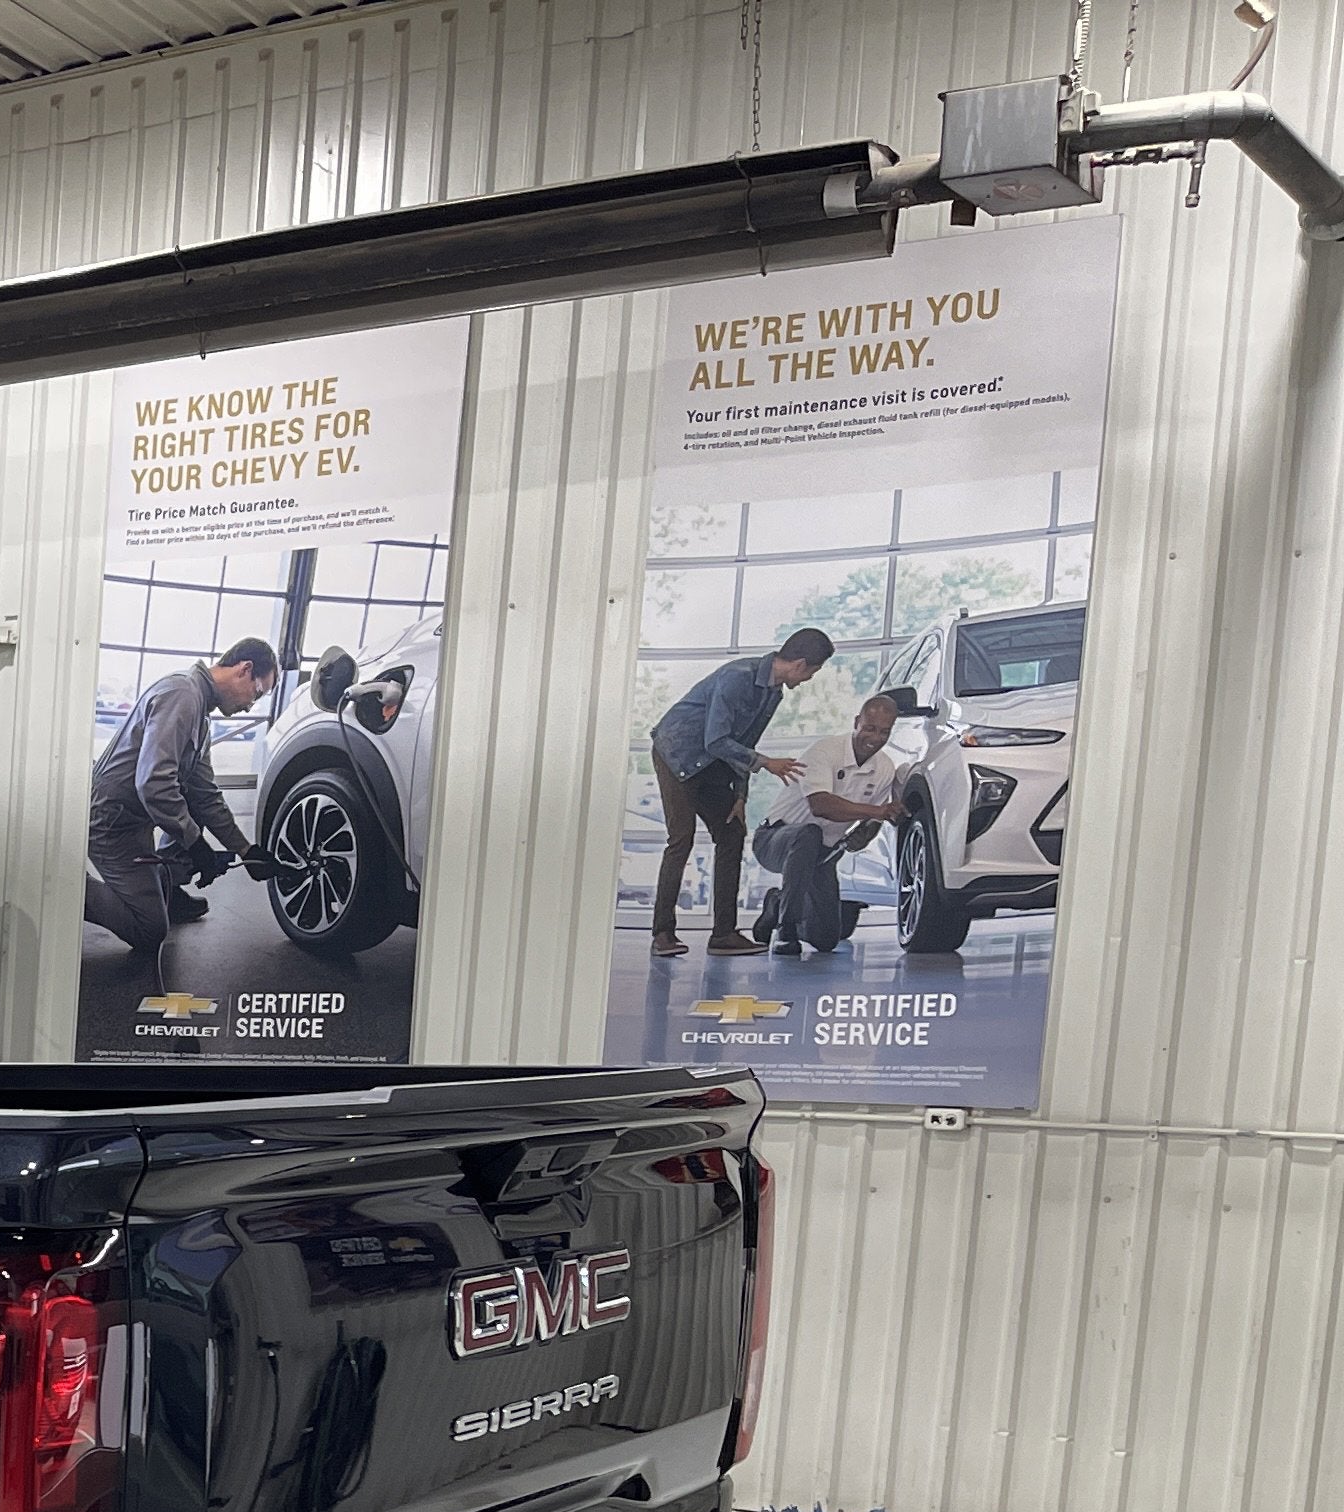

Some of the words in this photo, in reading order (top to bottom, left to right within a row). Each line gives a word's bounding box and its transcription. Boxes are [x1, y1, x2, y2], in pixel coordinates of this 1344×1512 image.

[695, 312, 807, 353] WE'RE
[818, 299, 913, 340] WITH
[927, 287, 1001, 326] YOU
[689, 357, 756, 392] ALL
[768, 346, 837, 384] THE
[849, 336, 935, 376] WAY.
[135, 398, 179, 427] WE
[187, 386, 273, 423] KNOW
[282, 376, 338, 410] THE
[686, 409, 722, 424] Your
[725, 405, 760, 421] first
[764, 396, 868, 418] maintenance
[871, 388, 907, 407] visit
[912, 387, 926, 402] is
[133, 428, 216, 461] RIGHT
[223, 417, 304, 452] TIRES
[314, 408, 372, 442] FOR
[130, 464, 202, 495] YOUR
[211, 451, 309, 488] CHEVY
[317, 445, 360, 477] EV.
[127, 508, 151, 522] Tire
[155, 506, 185, 520] Price
[189, 503, 226, 518] Match
[230, 497, 299, 514] Guarantee.
[237, 992, 345, 1014] CERTIFIED
[816, 993, 957, 1018] CERTIFIED
[134, 1024, 221, 1037] CHEVROLET
[235, 1017, 325, 1039] SERVICE
[681, 1031, 794, 1045] CHEVROLET
[813, 1022, 931, 1046] SERVICE
[447, 1248, 631, 1360] GMC
[452, 1373, 620, 1442] SIERRA
